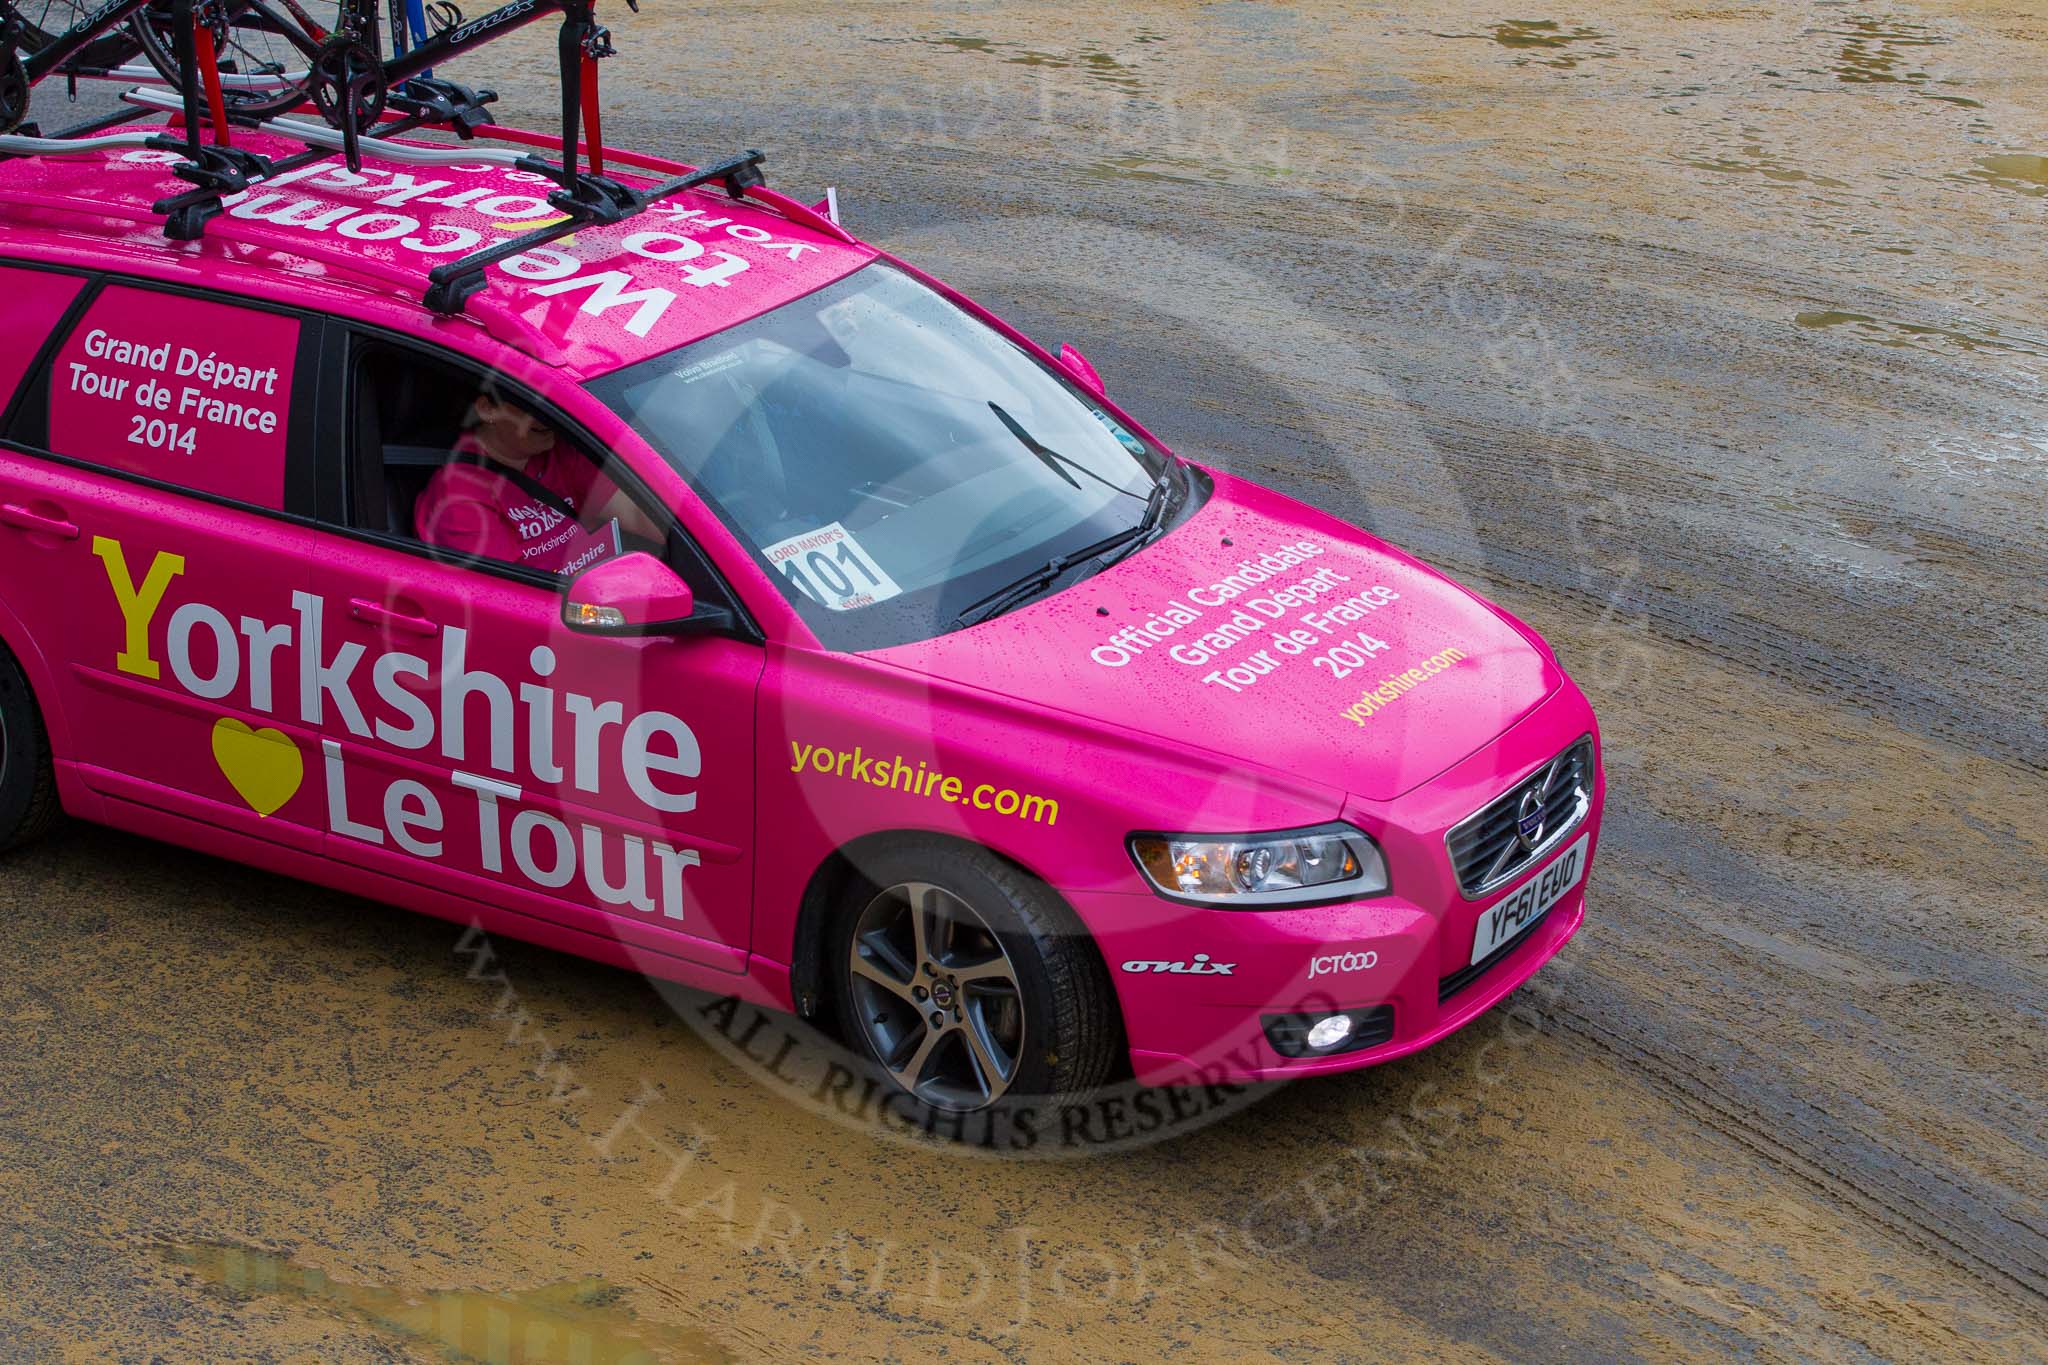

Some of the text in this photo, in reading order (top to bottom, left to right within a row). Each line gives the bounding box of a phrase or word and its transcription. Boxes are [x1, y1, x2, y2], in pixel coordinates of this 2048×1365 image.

[621, 231, 751, 288] to
[83, 329, 279, 397] Grand Départ
[68, 362, 277, 435] Tour de France
[127, 414, 197, 456] 2014
[519, 521, 542, 540] to
[556, 543, 605, 576] orkshire
[768, 529, 845, 565] LORD MAYOR'S
[785, 541, 881, 606] 101
[1090, 539, 1325, 668] Official Candidate
[1169, 565, 1351, 667] Grand Départ
[1202, 582, 1401, 694] Tour de France
[92, 536, 701, 814] Yorkshire
[1313, 632, 1391, 680] 2014
[1340, 646, 1468, 728] yorkshire.com
[790, 738, 1061, 828] yorkshire.com
[322, 739, 701, 921] Le Tour
[1490, 883, 1538, 945] YF61
[1121, 953, 1237, 975] onix
